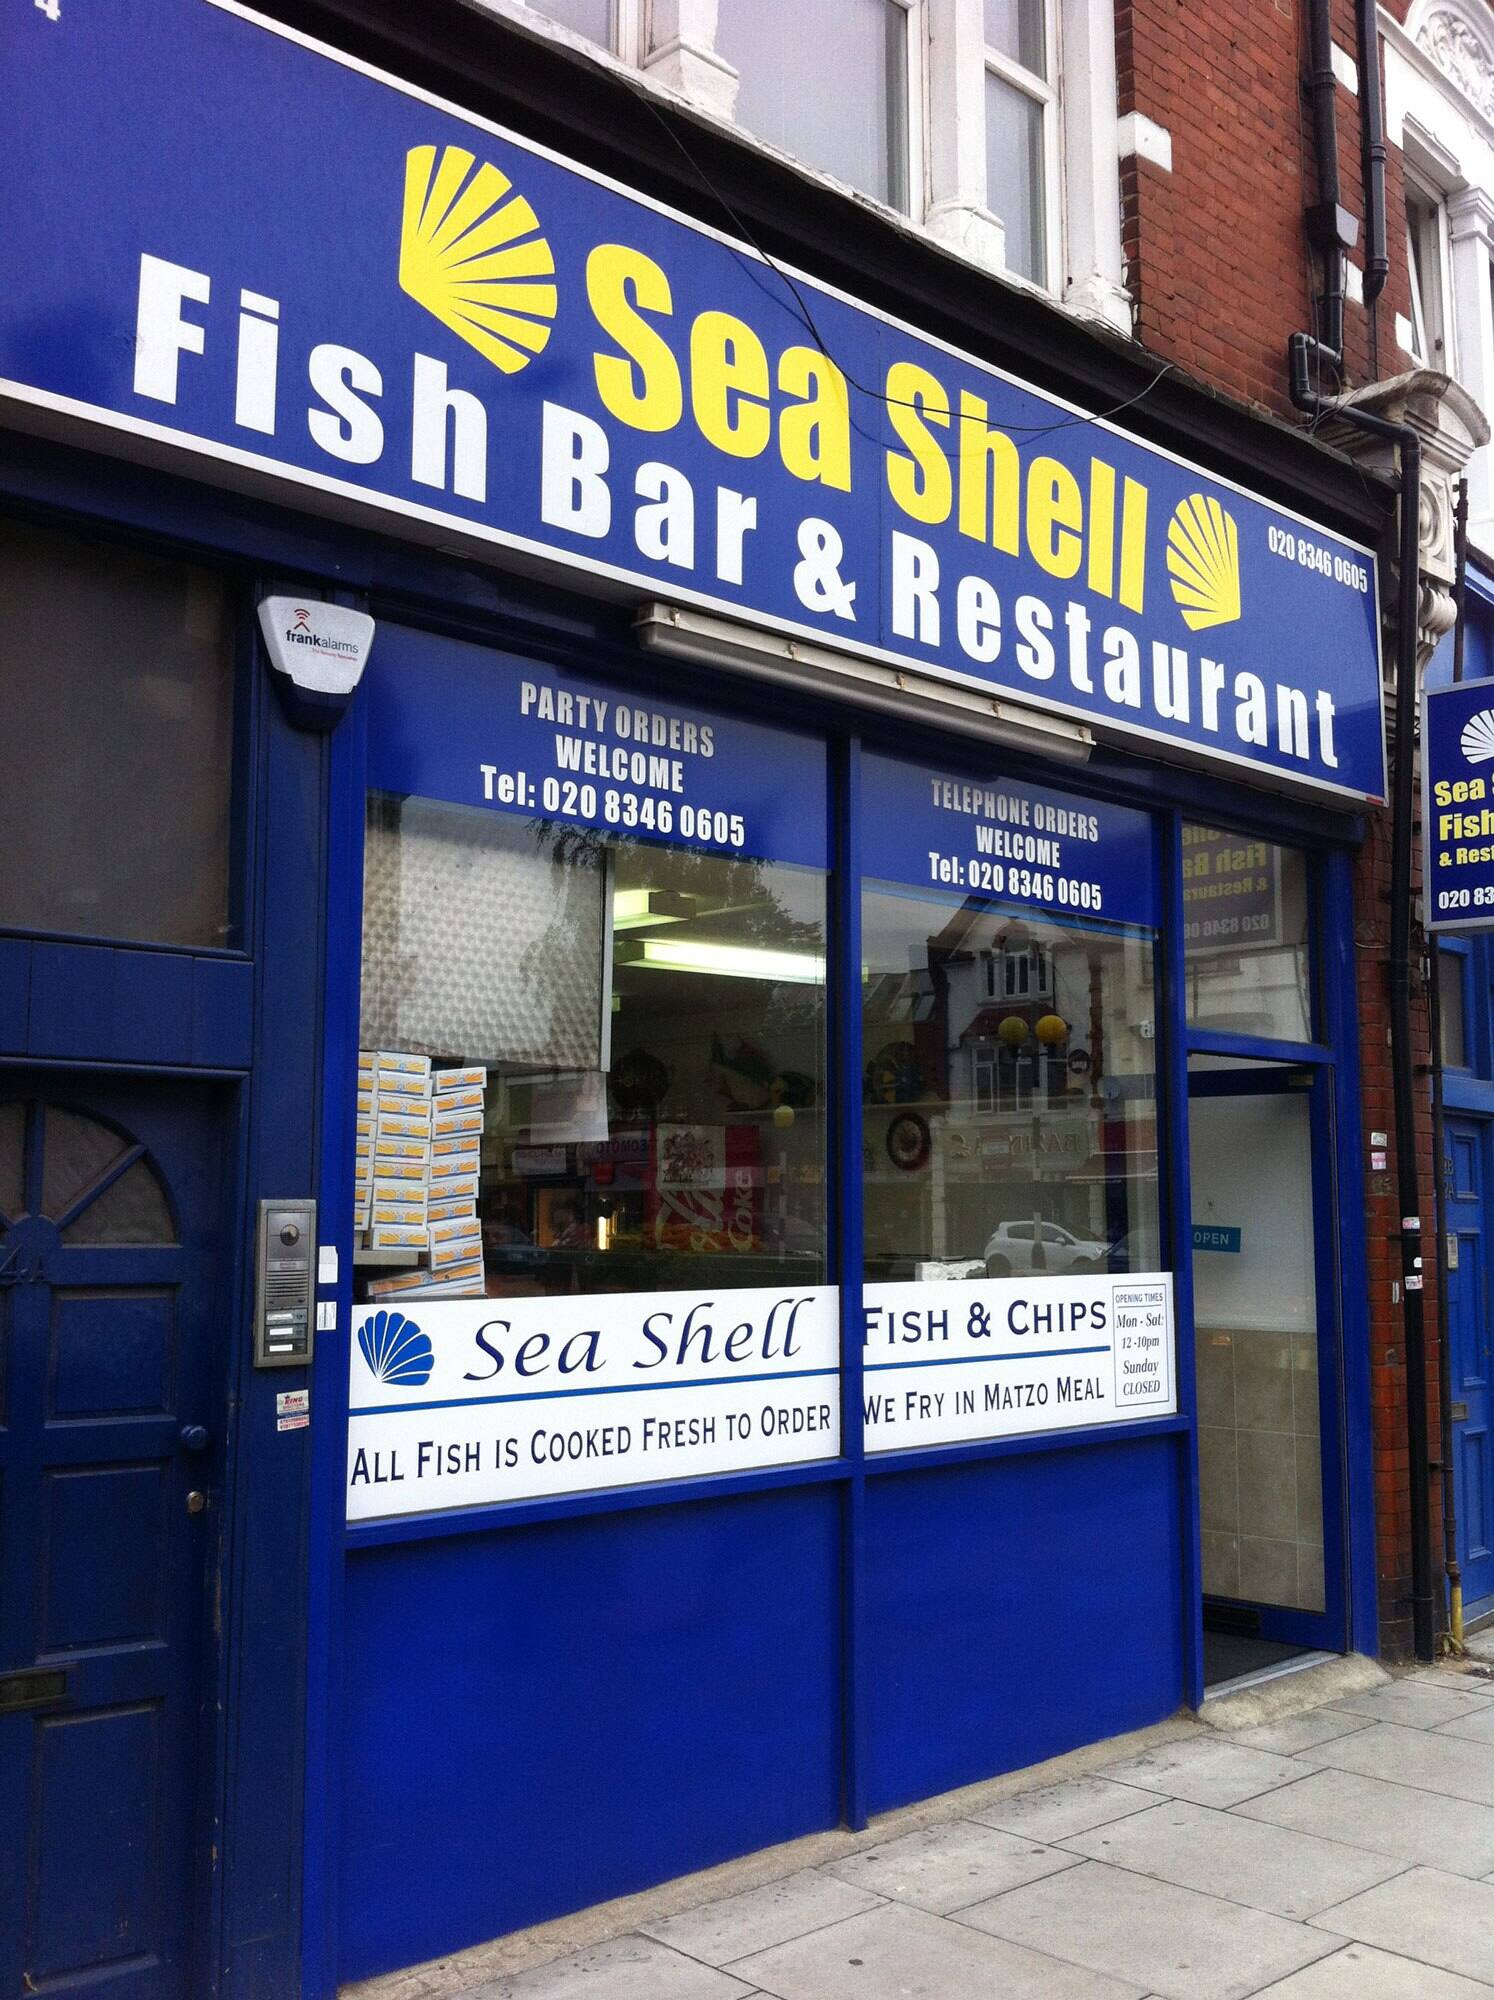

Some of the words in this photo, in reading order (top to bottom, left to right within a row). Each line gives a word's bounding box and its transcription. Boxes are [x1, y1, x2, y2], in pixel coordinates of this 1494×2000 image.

[586, 244, 852, 492] Sea
[886, 362, 1149, 615] Shell
[133, 253, 487, 503] Fish
[541, 400, 757, 586] Bar
[793, 518, 856, 622] &
[891, 530, 1338, 768] Restaurant
[1268, 526, 1295, 560] 020
[1298, 539, 1332, 577] 8346
[1334, 556, 1368, 593] 0605
[520, 681, 608, 733] PARTY
[615, 705, 714, 758] ORDERS
[555, 734, 684, 793] WELCOME
[480, 764, 535, 808] Tel:
[543, 777, 597, 819] 020
[605, 790, 673, 834] 8346
[680, 806, 745, 847] 0605
[931, 779, 1029, 827] TELEPHONE
[1034, 803, 1098, 842] ORDERS
[1435, 778, 1486, 807] Sea
[1440, 809, 1494, 841] Fish
[976, 825, 1060, 868] WELCOME
[1439, 852, 1453, 867] &
[929, 852, 964, 885] Tel:
[969, 859, 1004, 892] 020
[1009, 867, 1054, 901] 8346
[1058, 877, 1101, 911] 0605
[1438, 889, 1470, 909] 020
[1473, 886, 1494, 905] 83
[1194, 1232, 1229, 1245] OPEN
[1115, 1293, 1142, 1304] OPENING
[1144, 1292, 1163, 1302] TIMES
[462, 1320, 607, 1381] Sea
[632, 1297, 815, 1368] Shell
[967, 1302, 991, 1338] &
[1116, 1314, 1137, 1328] Mon
[1123, 1358, 1159, 1376] Sunday
[1123, 1380, 1161, 1396] CLOSED
